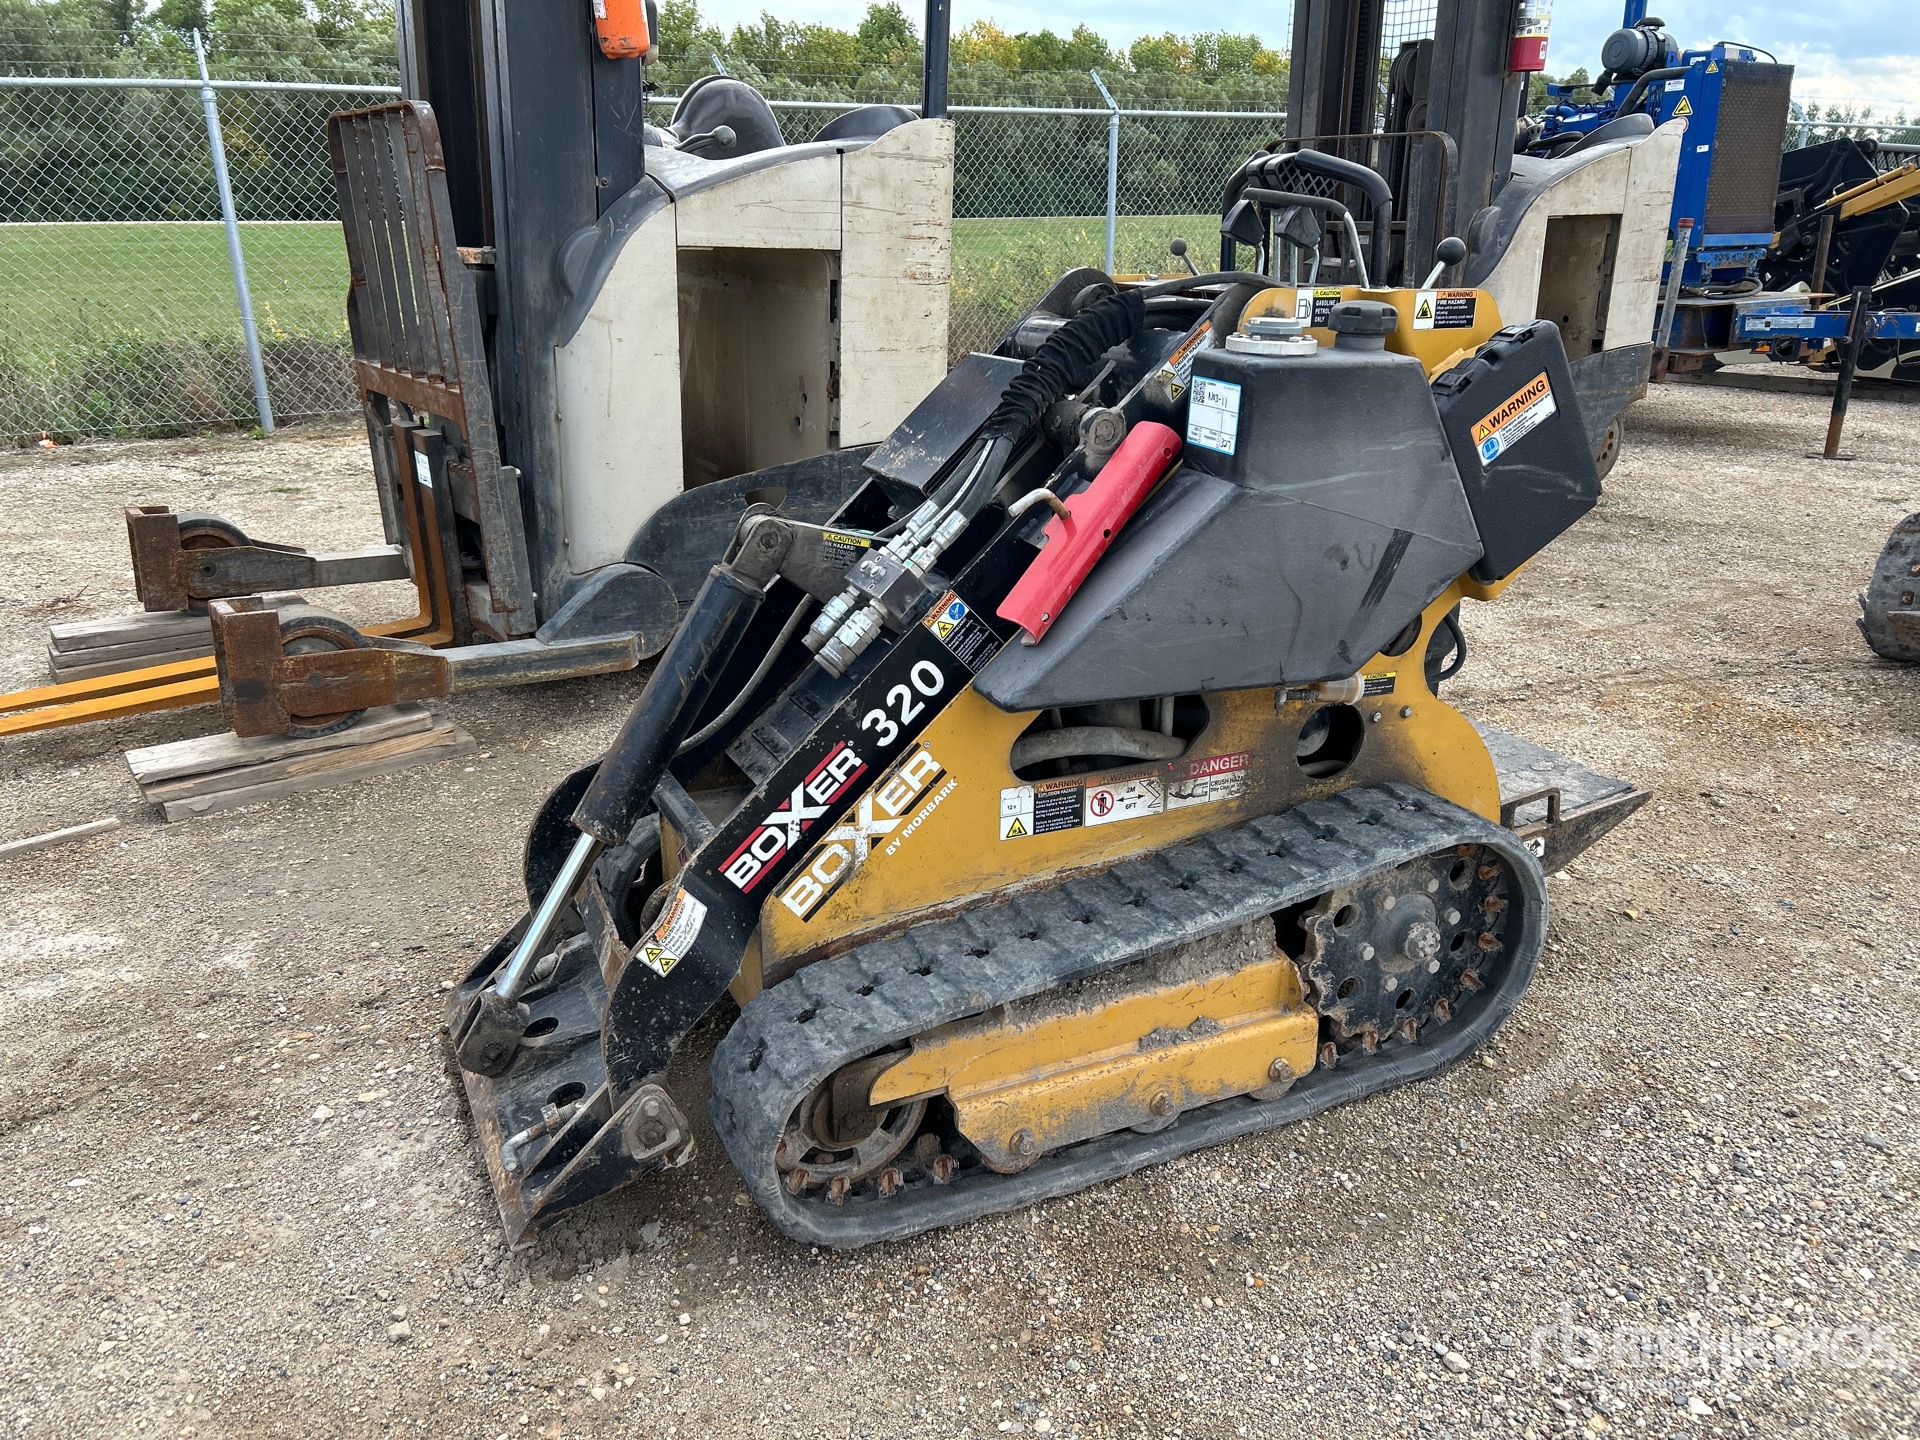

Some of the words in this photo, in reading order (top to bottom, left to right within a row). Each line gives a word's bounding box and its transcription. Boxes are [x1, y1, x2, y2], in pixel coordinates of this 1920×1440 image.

[1181, 328, 1203, 352] WARNING
[1174, 353, 1189, 368] CRUSH
[1177, 362, 1186, 373] Keep
[1489, 380, 1545, 428] WARNING
[833, 536, 861, 545] CAUTION
[930, 592, 955, 620] WARNING
[862, 660, 945, 747] 320
[1190, 754, 1248, 775] DANGER
[1046, 779, 1082, 790] WARNING
[1111, 770, 1153, 782] WARNING
[1211, 778, 1229, 786] CRUSH
[724, 747, 863, 889] BOXER
[885, 836, 901, 856] BY
[901, 777, 958, 838] MORBARK
[780, 750, 942, 919] BOXER
[666, 898, 681, 925] WARNING
[662, 927, 676, 943] CRUSH
[666, 935, 674, 946] Keep
